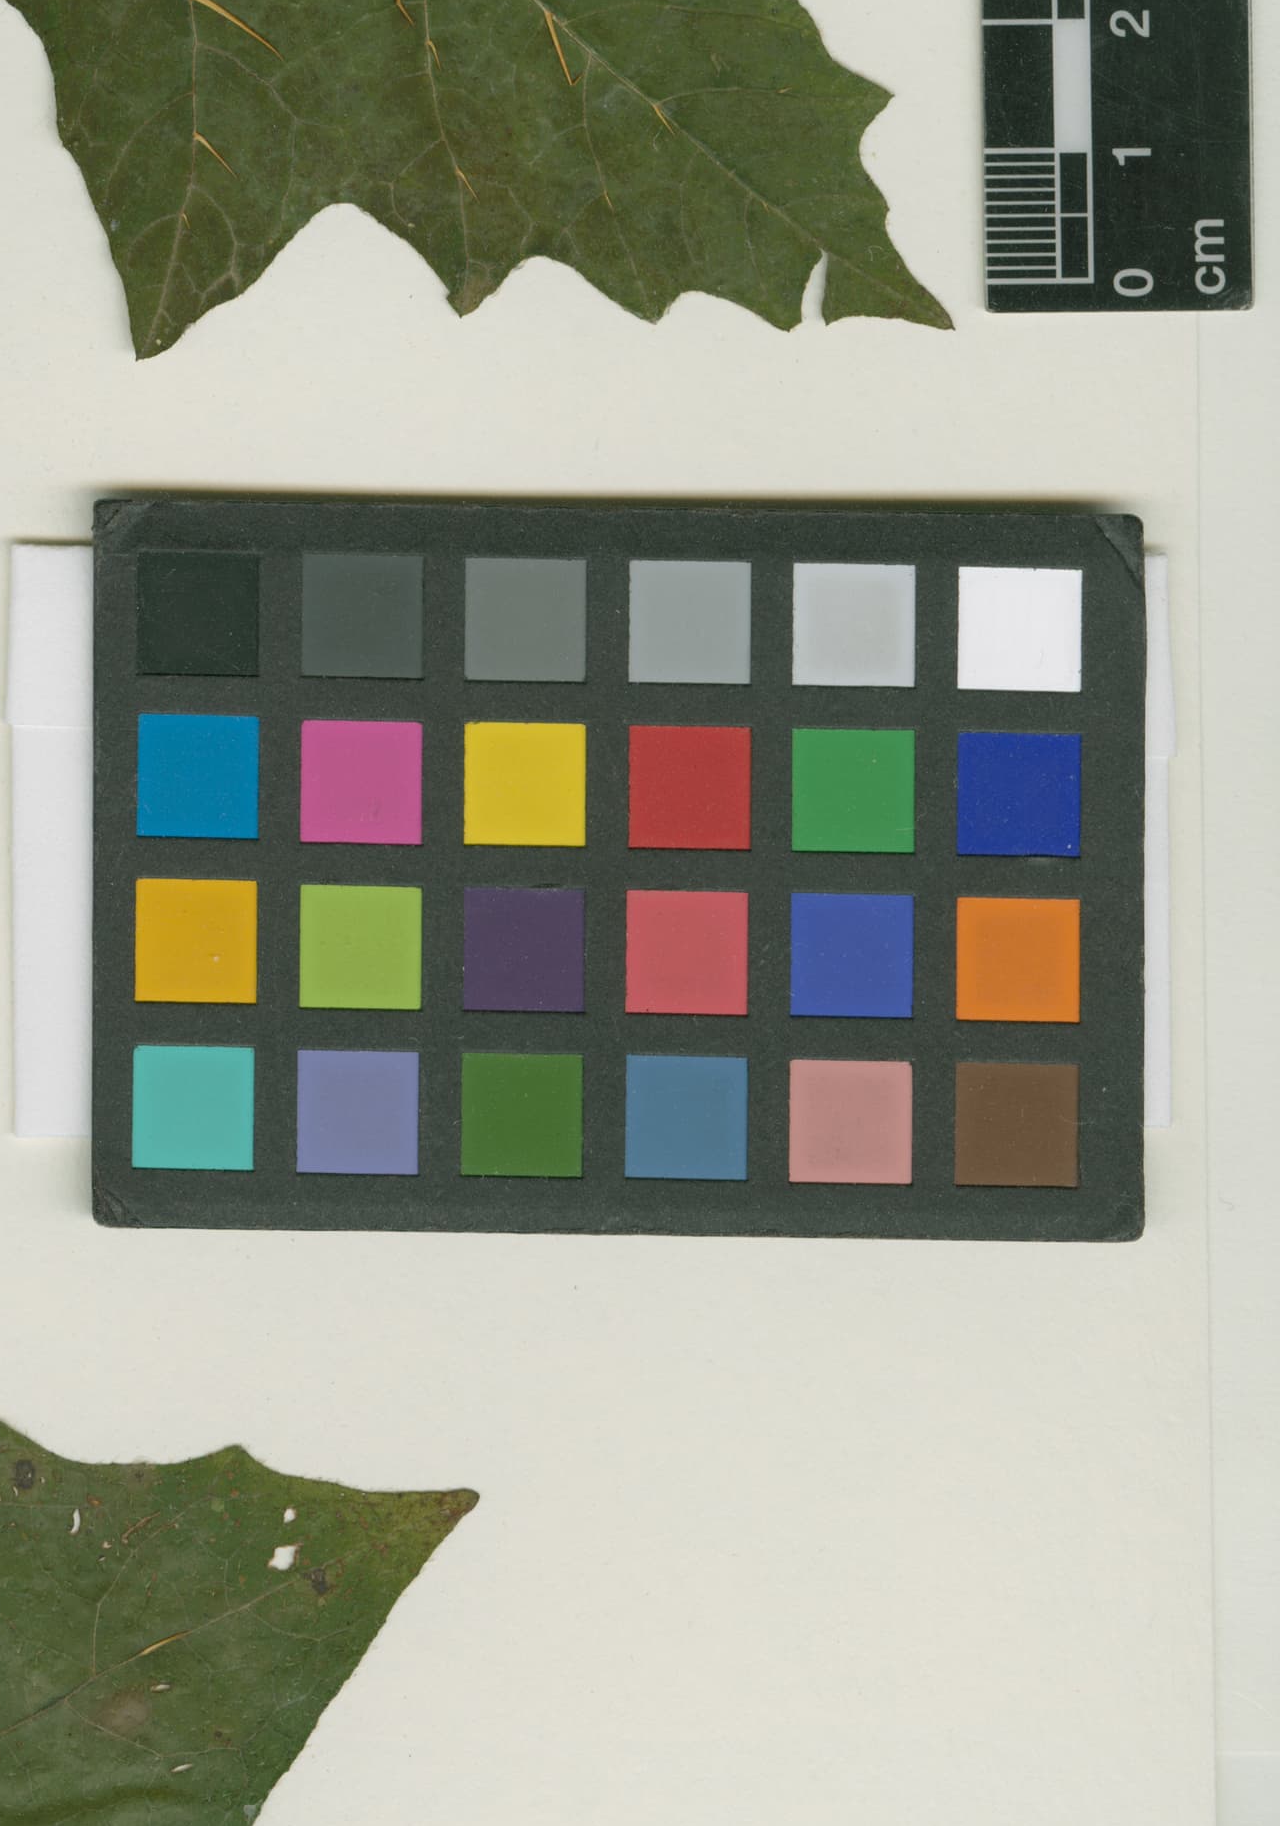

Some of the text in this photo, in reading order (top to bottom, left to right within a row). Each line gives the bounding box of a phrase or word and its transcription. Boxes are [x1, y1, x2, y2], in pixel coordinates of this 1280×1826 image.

[1110, 10, 1149, 37] 2
[1112, 148, 1151, 165] 1
[1195, 220, 1225, 294] cm
[1114, 269, 1153, 296] 0
